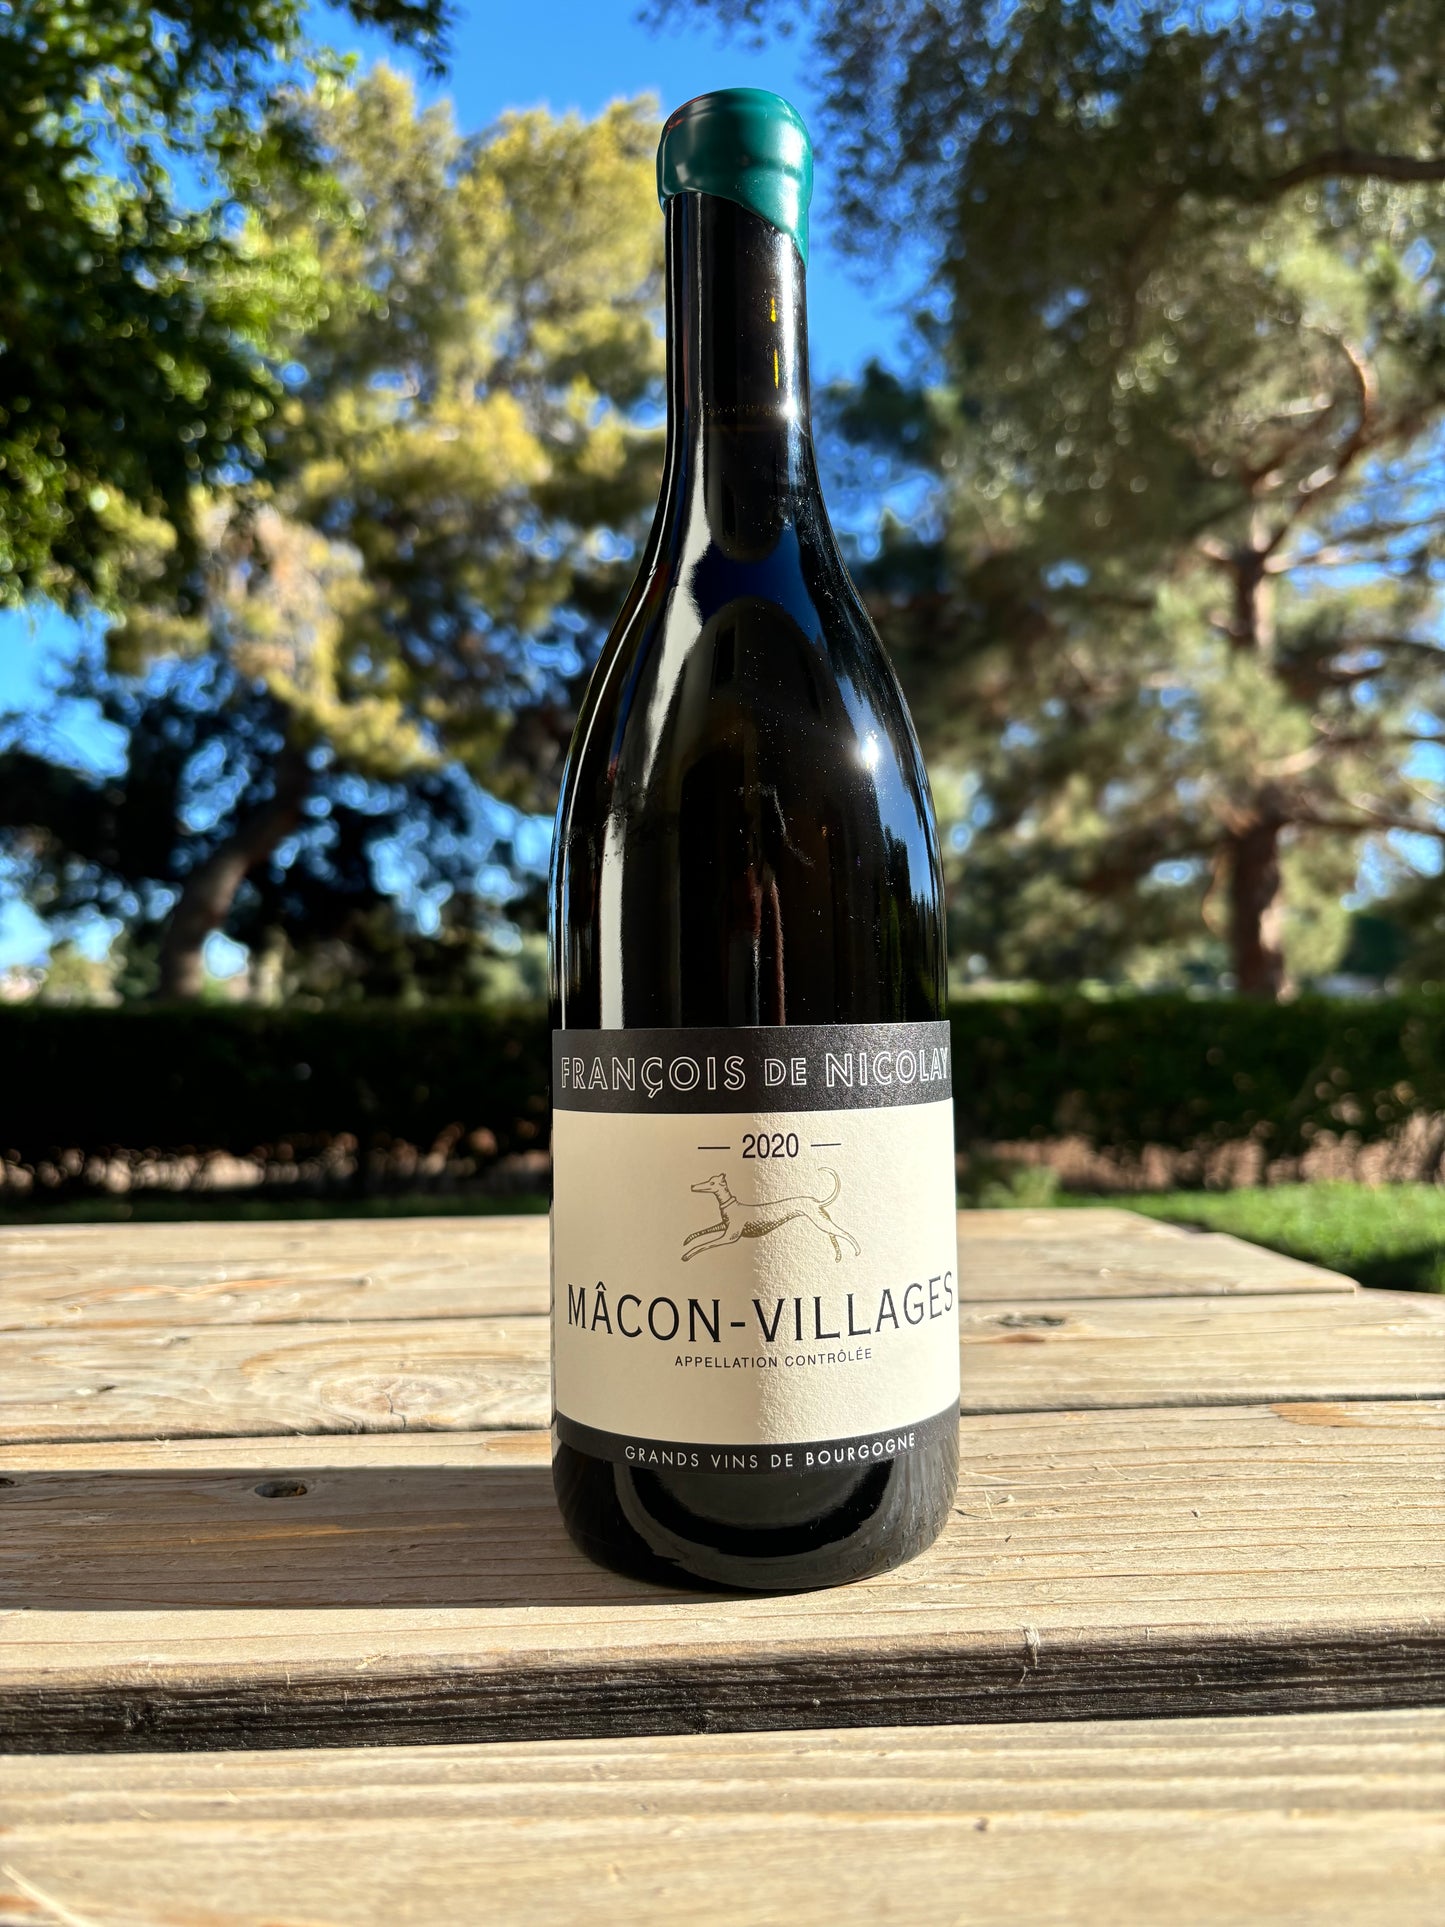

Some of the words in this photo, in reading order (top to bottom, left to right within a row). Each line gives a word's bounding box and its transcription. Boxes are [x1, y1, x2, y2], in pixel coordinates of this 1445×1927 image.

[561, 1055, 746, 1098] FRANÇOIS
[764, 1058, 807, 1086] DE
[825, 1046, 949, 1087] NICOLAY
[742, 1132, 799, 1158] 2020
[567, 1271, 954, 1343] MÂCON-VILLAGES
[674, 1355, 778, 1369] APPELLATION
[784, 1347, 873, 1367] CONTRÔLÉE
[624, 1445, 700, 1467] GRANDS
[711, 1454, 759, 1469] VINS
[770, 1453, 794, 1468] DE
[805, 1432, 915, 1466] BOURGOGNE
